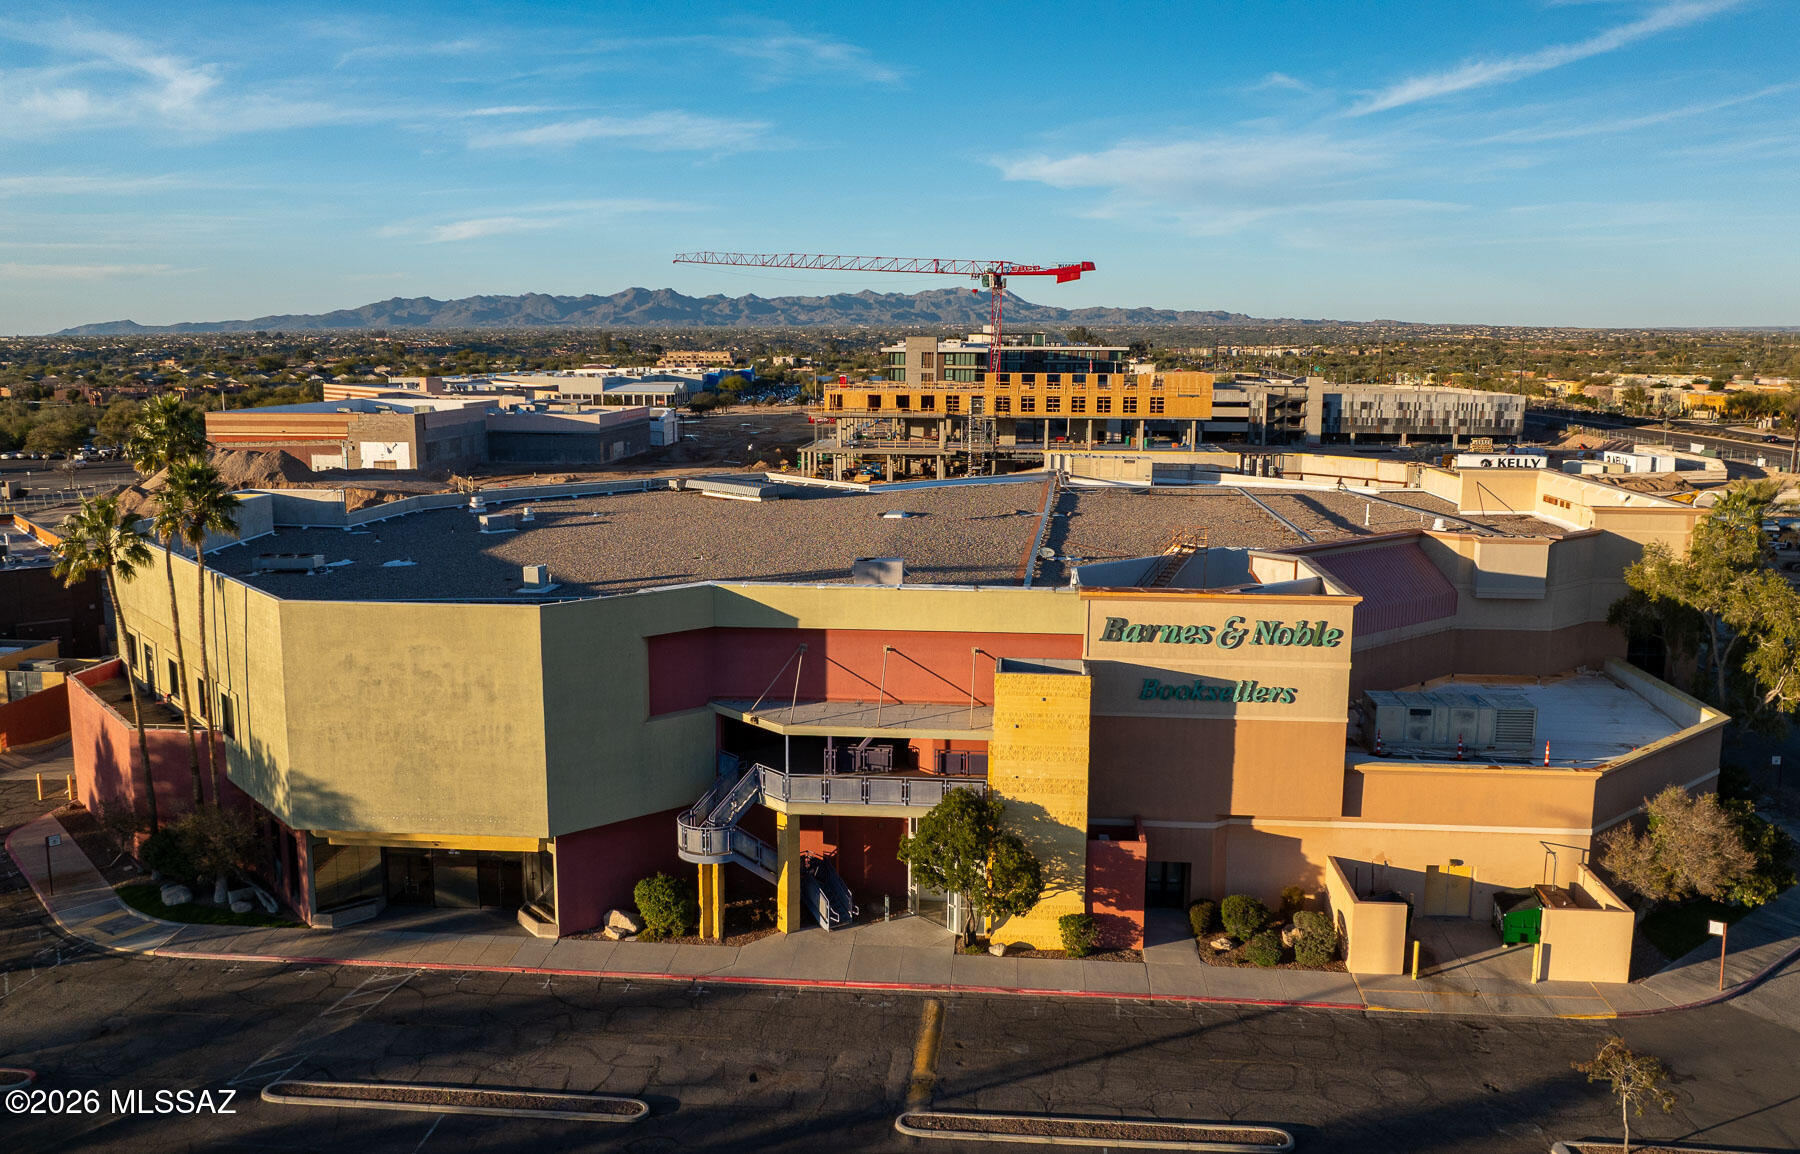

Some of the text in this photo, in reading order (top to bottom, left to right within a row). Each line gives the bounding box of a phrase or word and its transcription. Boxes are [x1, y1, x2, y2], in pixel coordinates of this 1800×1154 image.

[1497, 458, 1541, 468] KELLY
[1099, 616, 1344, 649] Barnes & Noble
[1140, 678, 1298, 704] Booksellers
